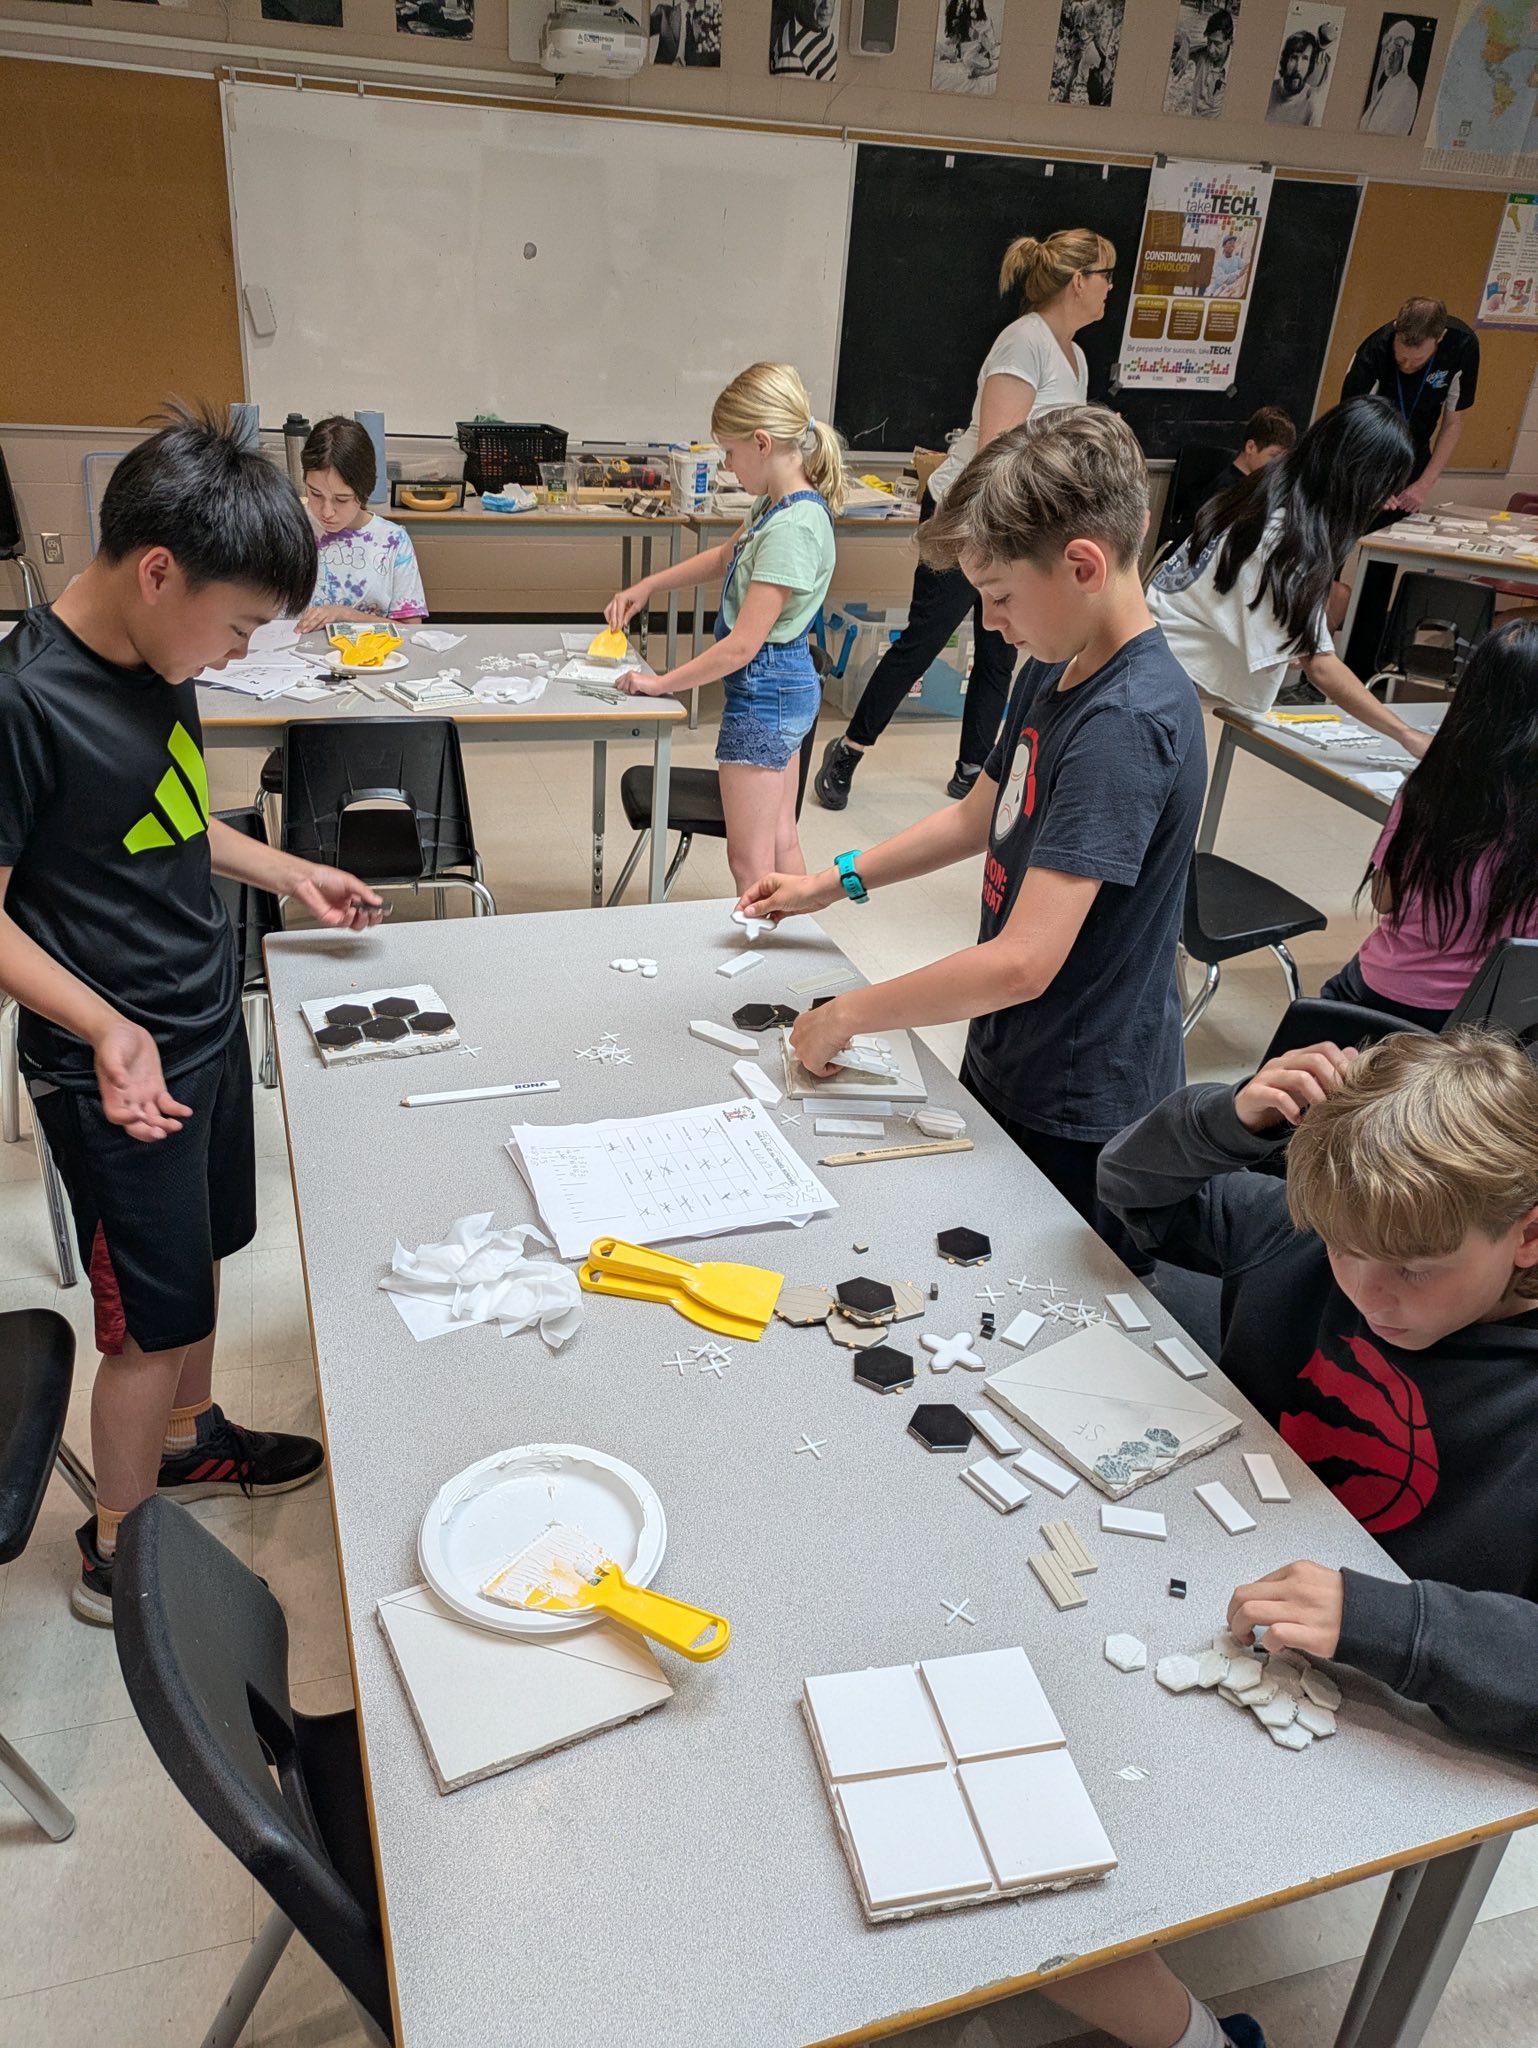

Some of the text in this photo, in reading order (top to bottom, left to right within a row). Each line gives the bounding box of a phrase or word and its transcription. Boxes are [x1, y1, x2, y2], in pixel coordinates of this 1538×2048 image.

[1144, 250, 1201, 264] CONSTRUCTION
[1143, 261, 1191, 273] TECHNOLOGY
[1136, 345, 1163, 354] prepared
